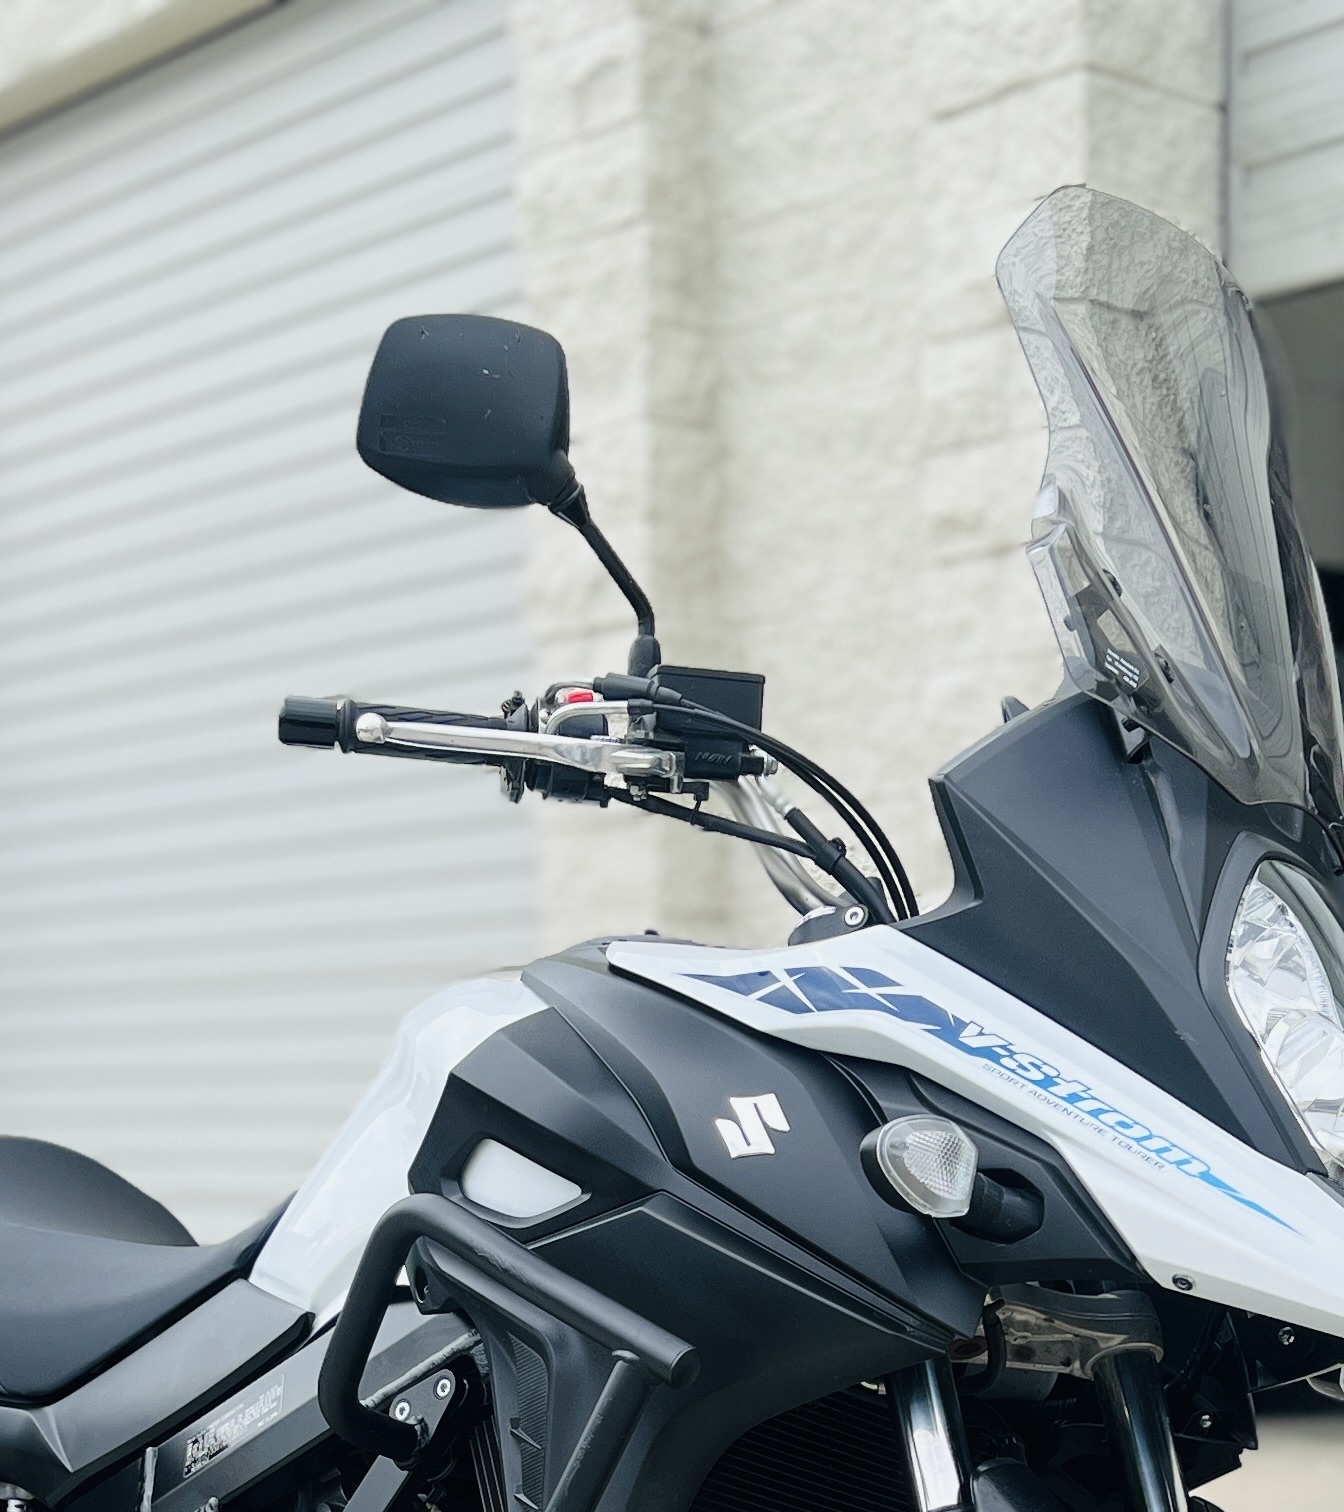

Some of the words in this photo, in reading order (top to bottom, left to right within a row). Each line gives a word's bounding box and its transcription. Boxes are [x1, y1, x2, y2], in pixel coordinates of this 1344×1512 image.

[982, 1063, 1026, 1090] SPORT
[1028, 1089, 1107, 1136] ADVENTURE
[1111, 1135, 1167, 1171] TOURER
